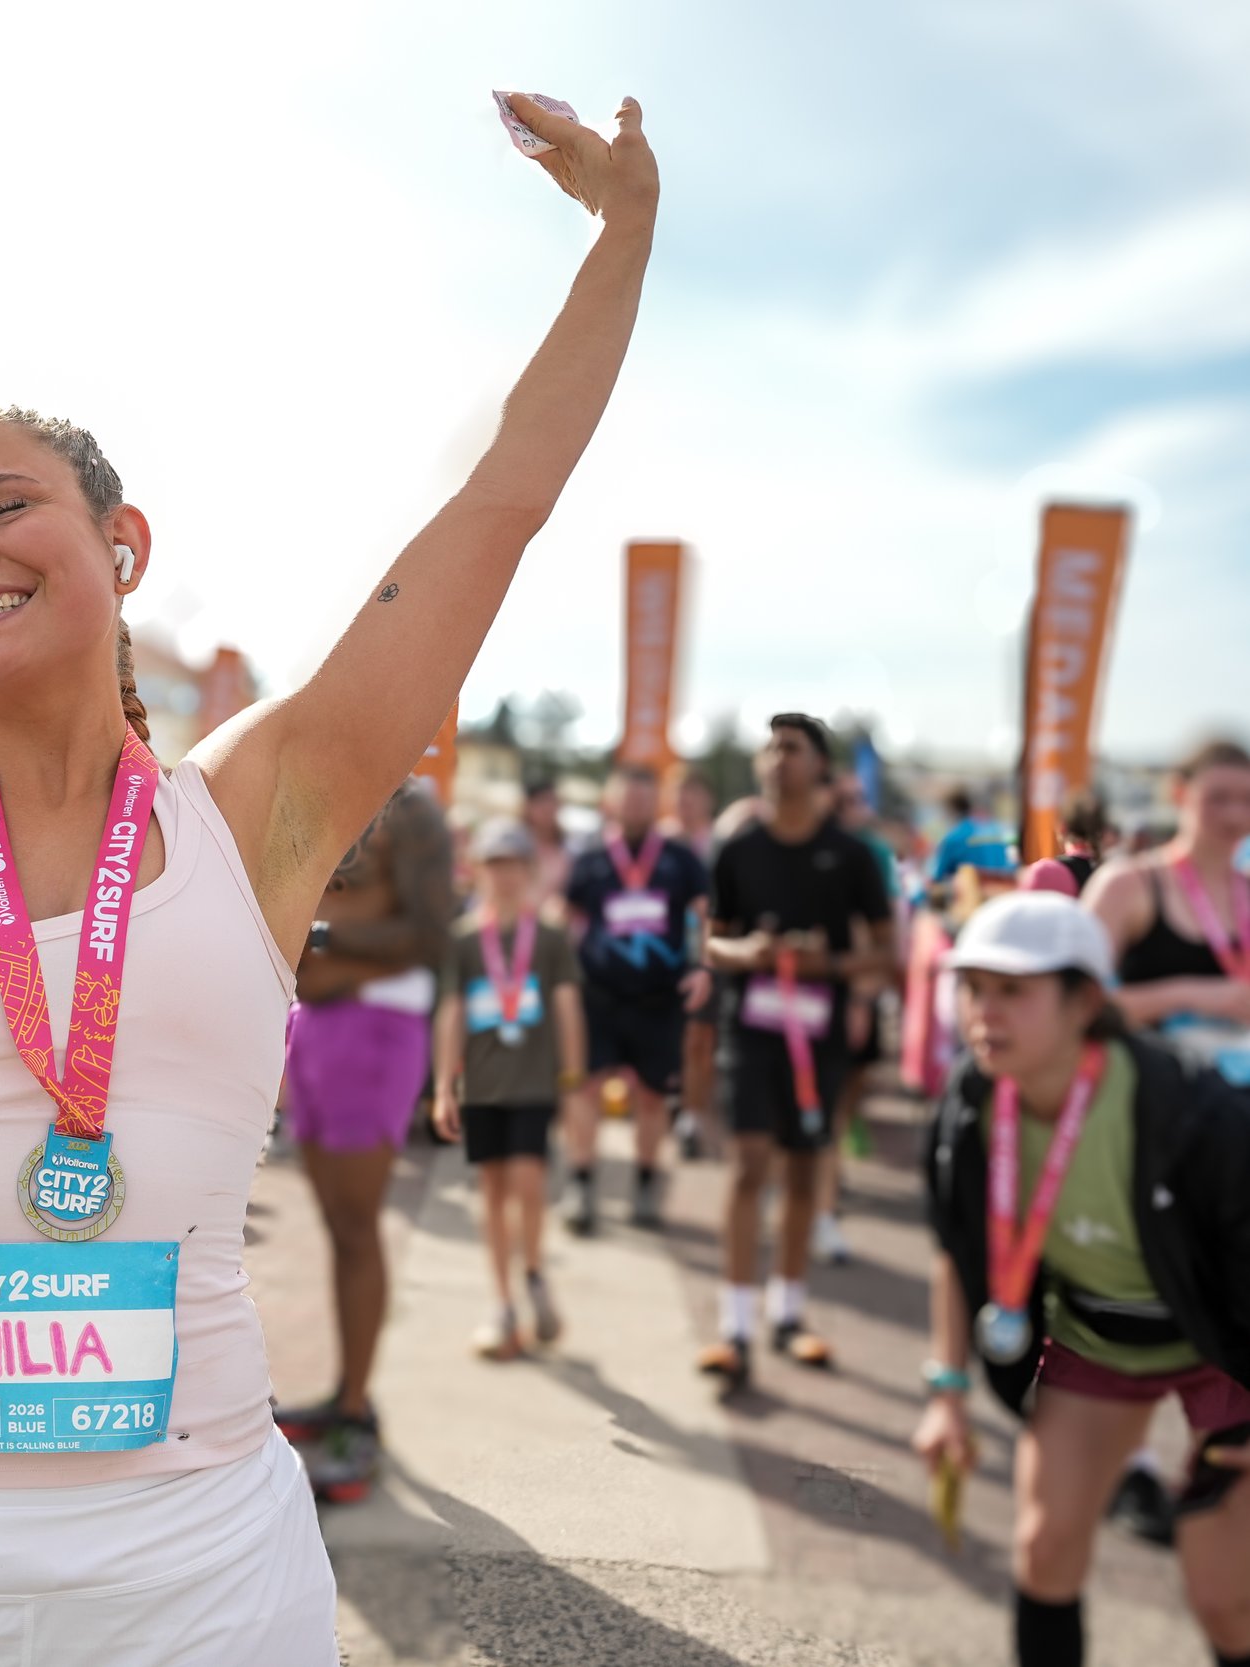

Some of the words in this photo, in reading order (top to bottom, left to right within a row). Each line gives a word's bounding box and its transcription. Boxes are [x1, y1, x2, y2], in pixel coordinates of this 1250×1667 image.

[121, 785, 141, 817] Voltaren
[89, 821, 137, 962] CITY2SURF
[63, 1156, 99, 1171] Voltaren
[37, 1168, 109, 1197] CITY2
[37, 1189, 102, 1215] SURF
[8, 1404, 45, 1416] 2026
[71, 1402, 155, 1431] 67218
[8, 1421, 46, 1433] BLUE
[6, 1442, 14, 1450] IS
[16, 1442, 55, 1450] CALLING
[57, 1441, 80, 1449] BLUE
